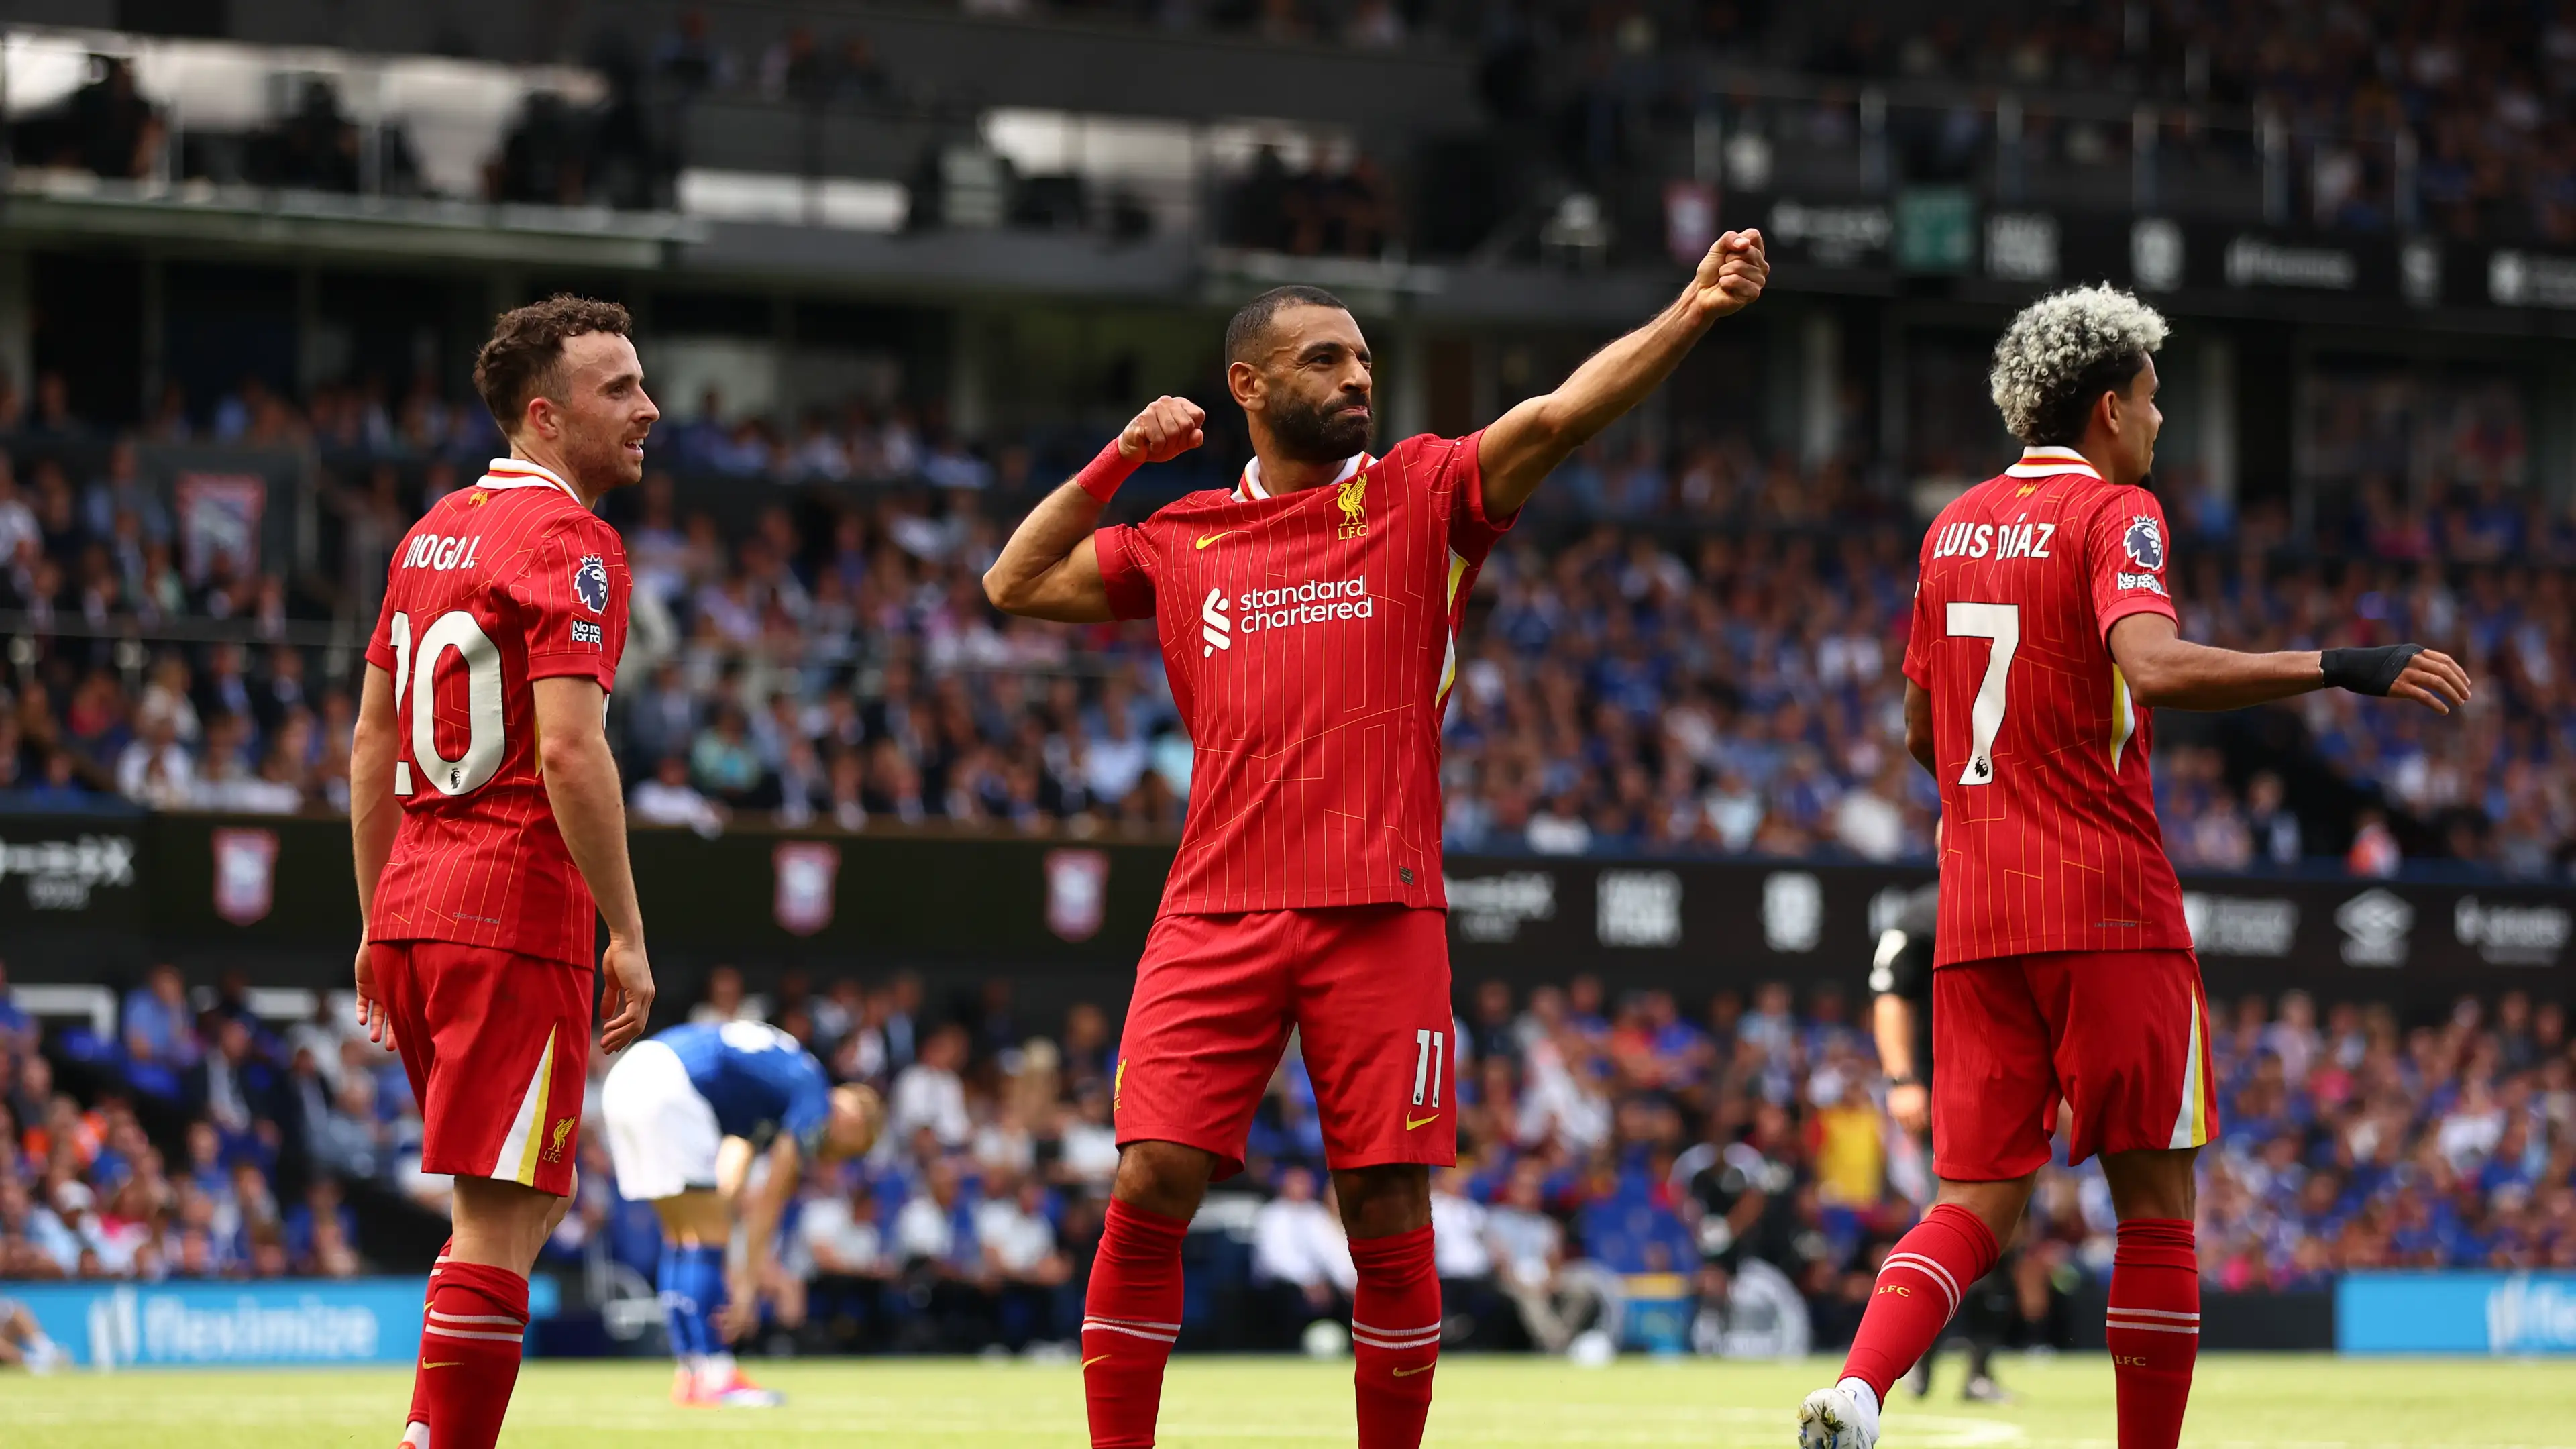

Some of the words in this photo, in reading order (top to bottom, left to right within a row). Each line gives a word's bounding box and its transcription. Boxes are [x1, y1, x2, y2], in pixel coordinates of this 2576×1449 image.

[402, 534, 468, 571] DIOGO
[460, 536, 481, 569] J.
[1933, 522, 1994, 559] LUIS
[1996, 513, 2055, 561] DÍAZ
[1240, 575, 1364, 612] standard
[2118, 572, 2136, 583] No
[572, 621, 589, 633] No
[1241, 596, 1373, 633] chartered
[572, 631, 588, 642] for
[1947, 603, 2019, 785] 7
[1412, 1028, 1444, 1108] 11
[1877, 1285, 1911, 1297] LFC
[2114, 1355, 2146, 1366] LFC
